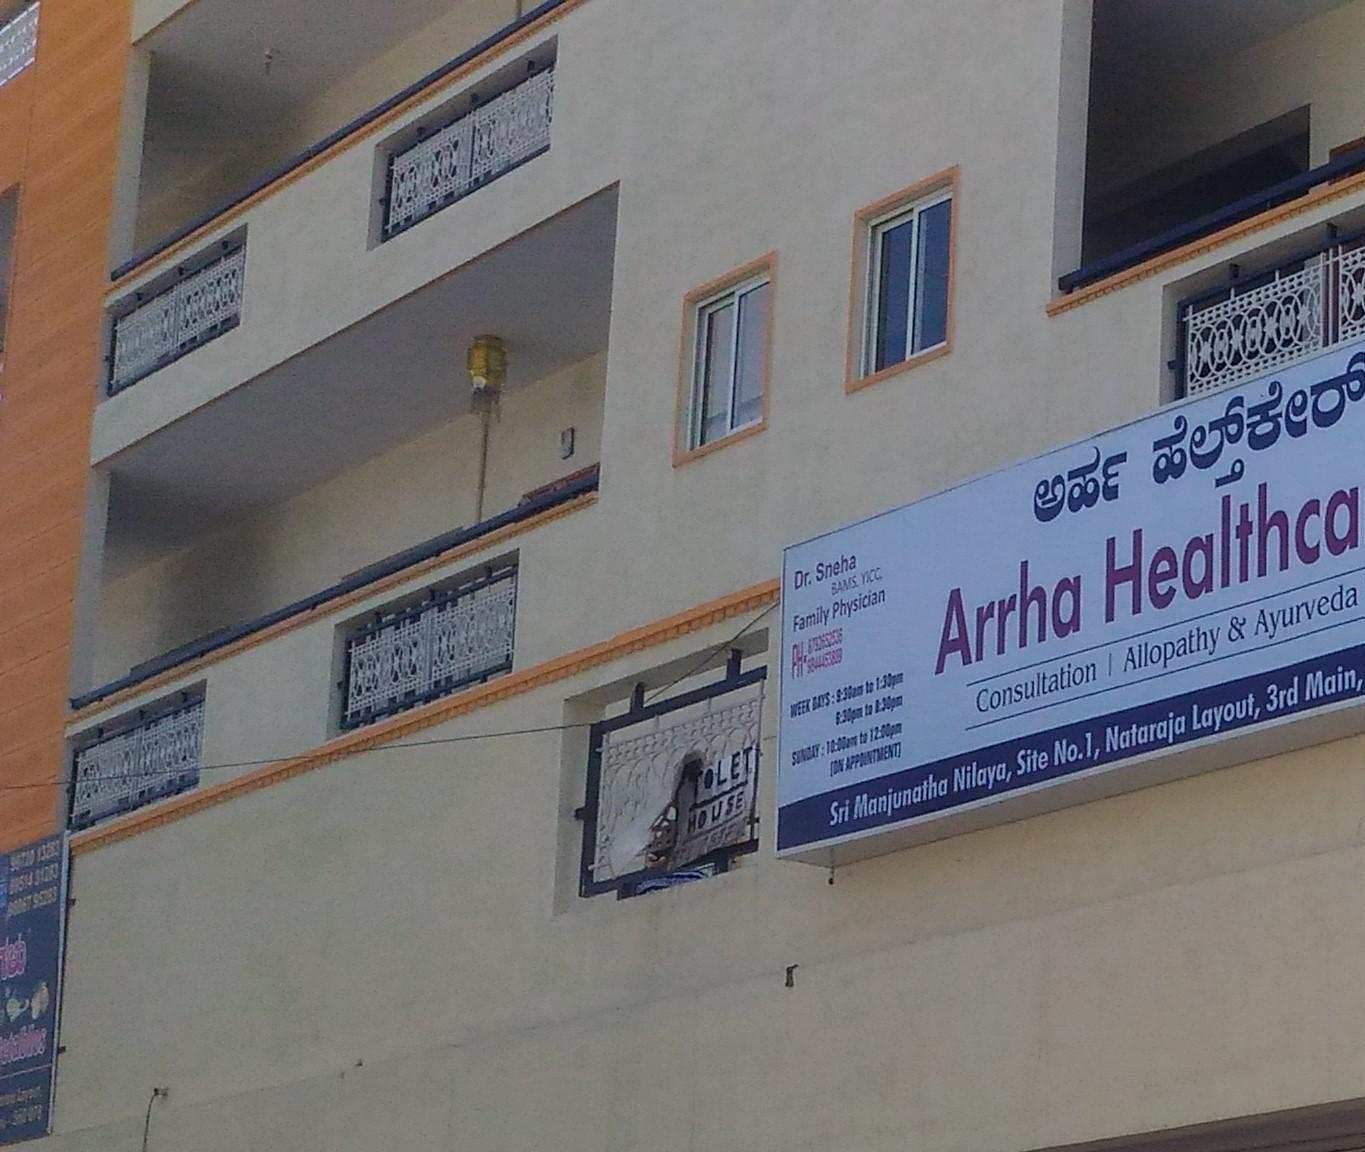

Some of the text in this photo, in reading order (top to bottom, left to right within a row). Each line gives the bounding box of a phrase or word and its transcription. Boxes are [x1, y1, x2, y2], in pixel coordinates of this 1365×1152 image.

[794, 554, 857, 590] Dr. Sneha
[793, 589, 886, 632] Family Physician
[934, 560, 1081, 676] Arrha
[976, 661, 1097, 713] Consultation
[1124, 625, 1221, 673] Allopathy
[1227, 614, 1248, 642] &
[1254, 583, 1359, 639] Ayurveda
[790, 698, 810, 718] WEEK
[792, 743, 821, 766] SUNDAY
[830, 798, 849, 826] Sri
[853, 773, 949, 820] Manjunatha
[953, 757, 1013, 792] Nilaya,
[1016, 741, 1049, 776] Site
[1053, 732, 1101, 766] No.1,
[1105, 710, 1187, 754] Nataraja
[1191, 695, 1261, 731] Layout,
[1266, 677, 1299, 710] 3rd
[1305, 665, 1363, 702] Main,
[687, 790, 745, 833] HOUSE
